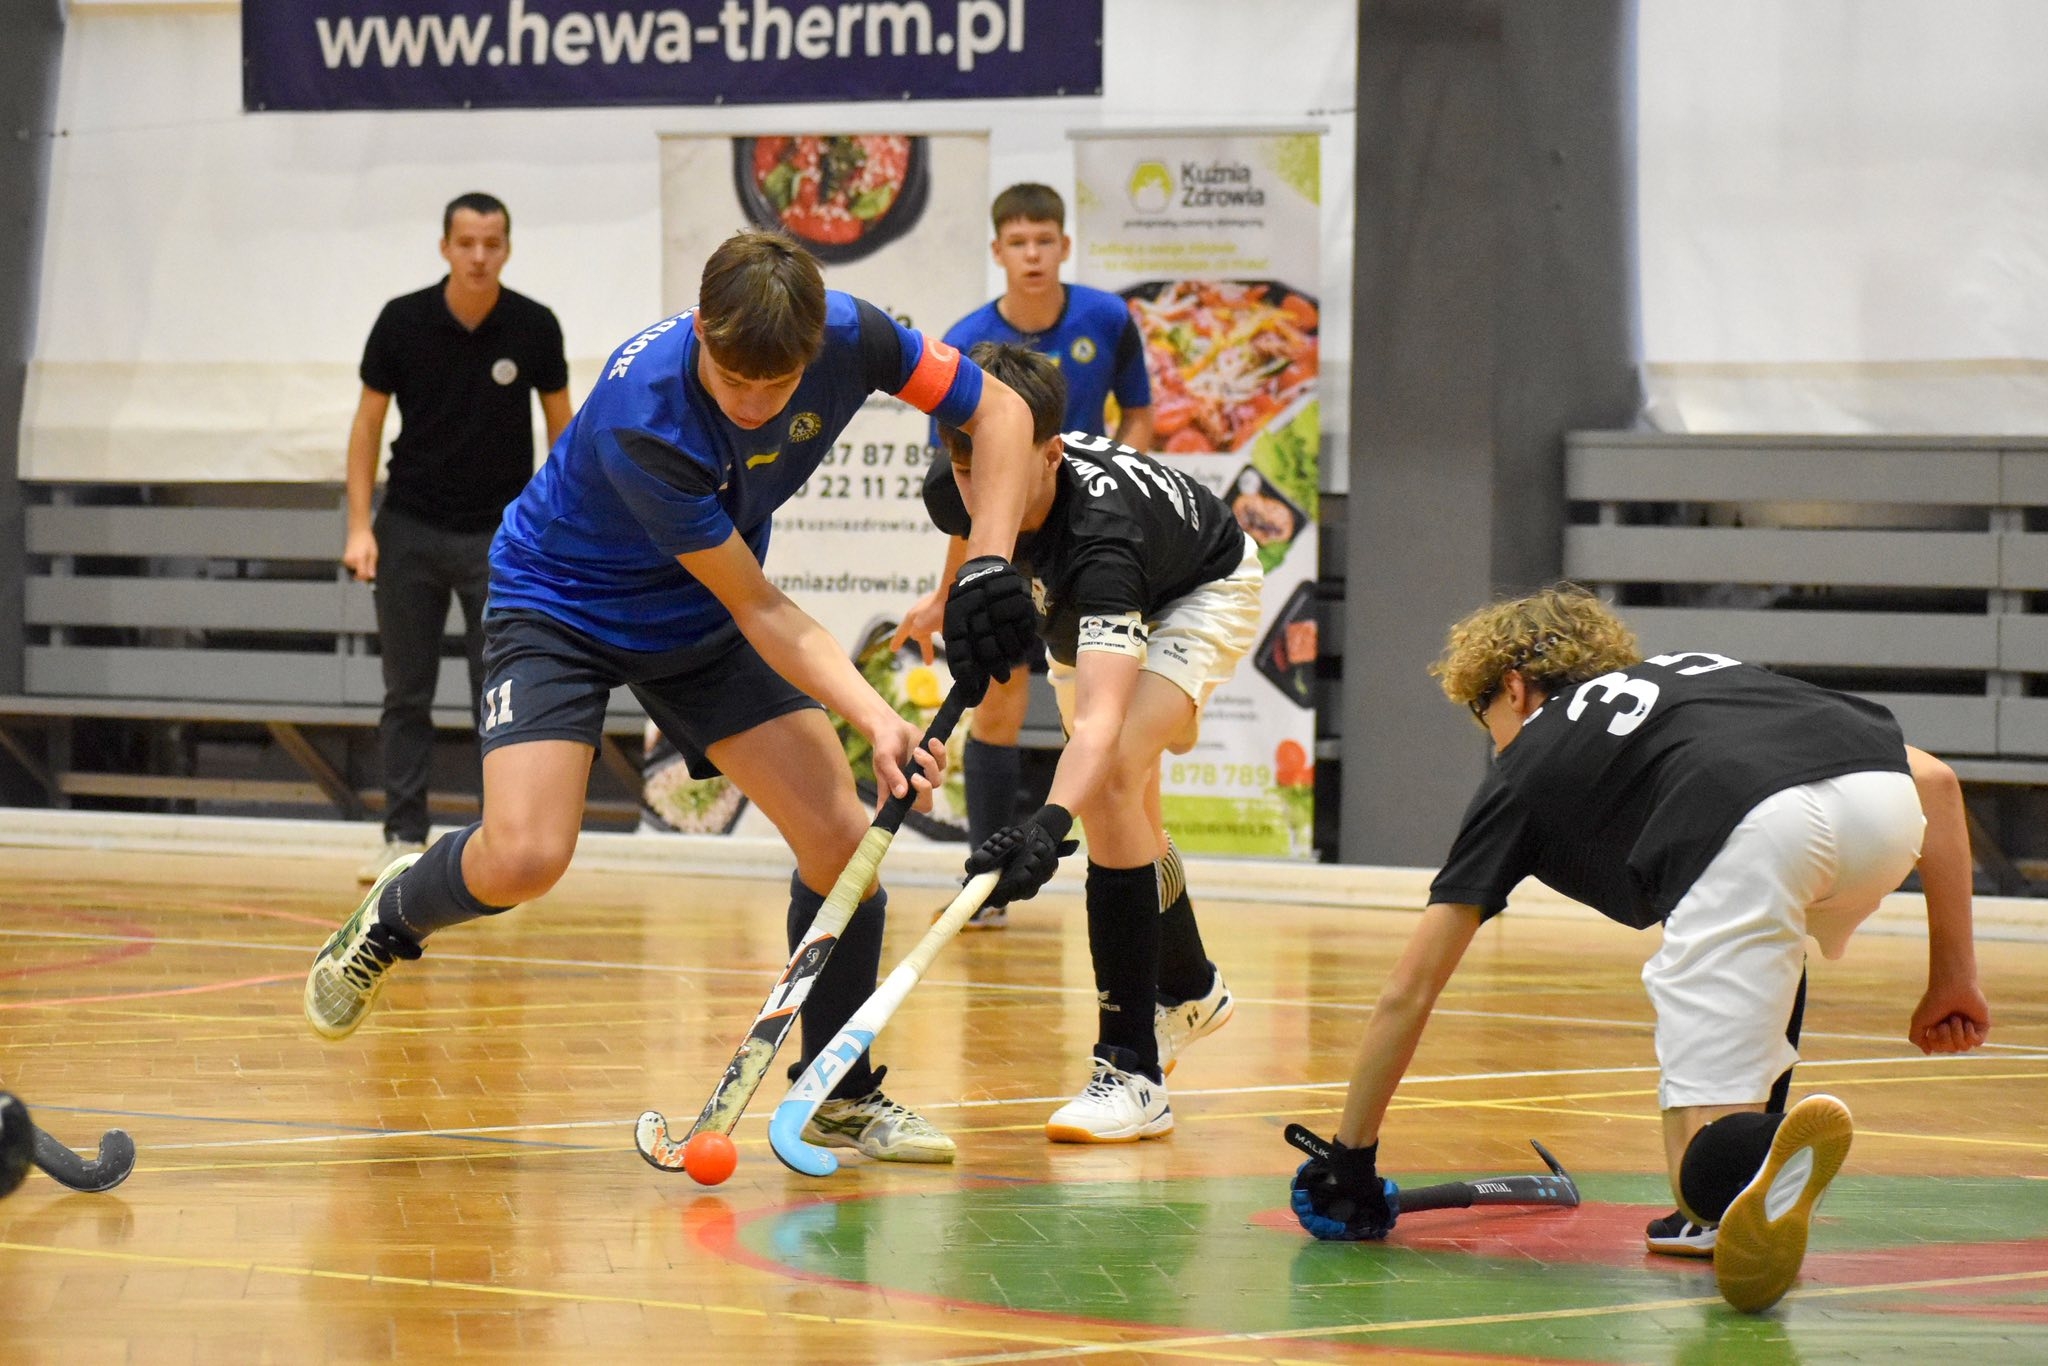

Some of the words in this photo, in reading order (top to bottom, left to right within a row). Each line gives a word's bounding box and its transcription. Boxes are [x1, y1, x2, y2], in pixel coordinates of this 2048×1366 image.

[314, 0, 1025, 72] www.hewa-therm.pl
[1182, 186, 1265, 208] Zdrowia
[863, 444, 894, 466] 87
[820, 476, 851, 498] 22
[863, 476, 884, 498] 11
[1163, 649, 1189, 665] erima
[485, 678, 513, 732] 11
[1170, 762, 1217, 787] 878
[1223, 763, 1272, 788] 789
[1294, 1132, 1330, 1160] MALIK
[1474, 1182, 1512, 1194] RITUAL
